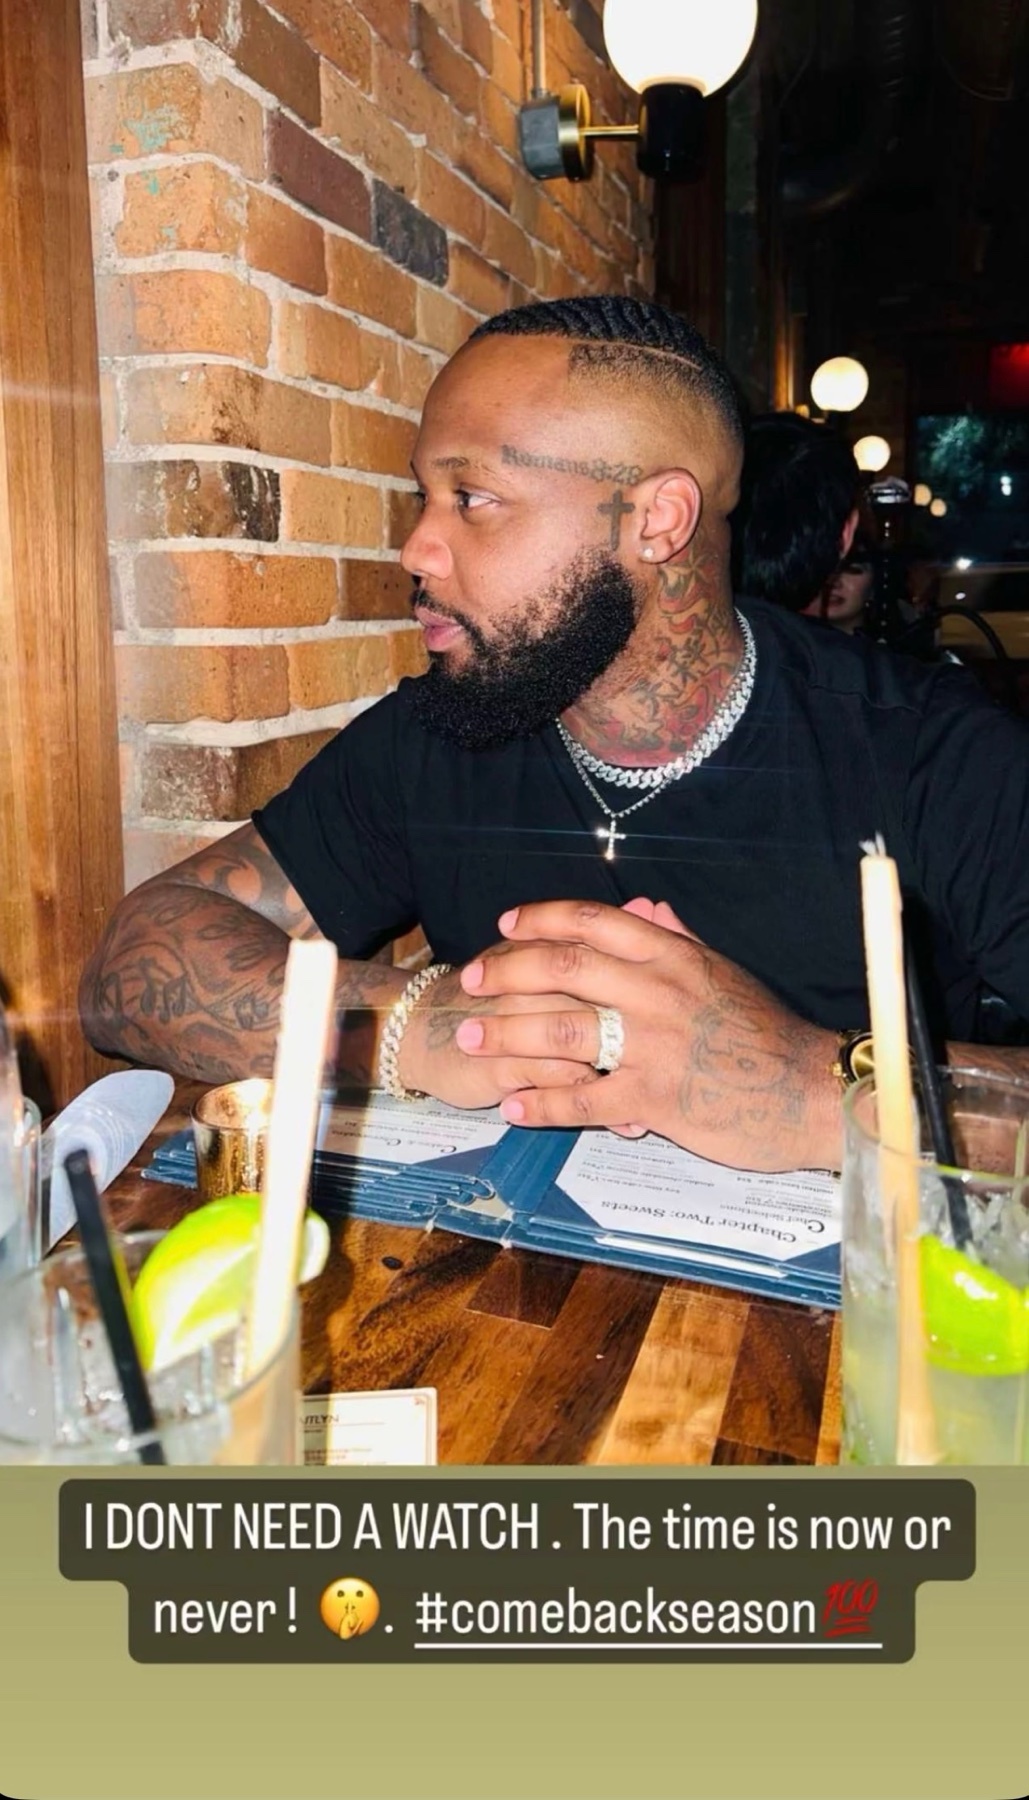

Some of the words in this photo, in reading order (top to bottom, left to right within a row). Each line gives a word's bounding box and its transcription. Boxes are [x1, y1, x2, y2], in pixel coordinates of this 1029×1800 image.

[600, 1200, 666, 1219] Sweets
[669, 1210, 715, 1227] Two:
[718, 1217, 798, 1243] Chapter
[785, 1215, 826, 1234] Chef
